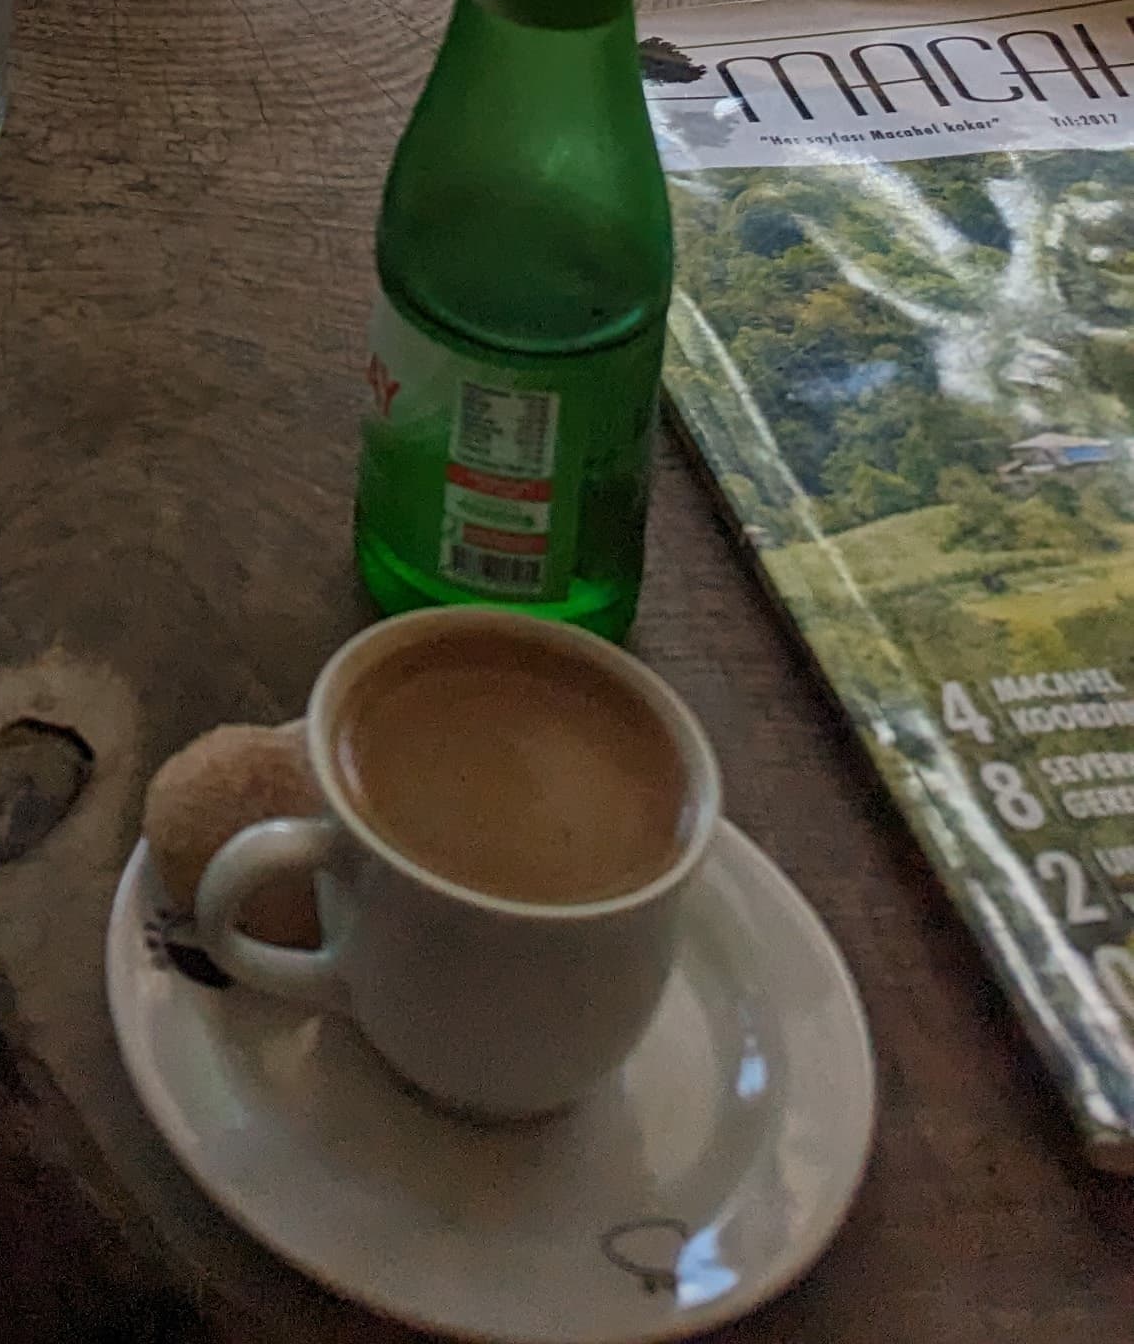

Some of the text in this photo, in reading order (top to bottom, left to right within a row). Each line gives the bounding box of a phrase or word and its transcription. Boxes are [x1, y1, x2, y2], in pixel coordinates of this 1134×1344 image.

[869, 122, 940, 140] Macahel
[940, 679, 995, 745] 4
[993, 668, 1126, 701] MACAHEL
[980, 760, 1045, 831] 8
[1035, 850, 1108, 926] 2
